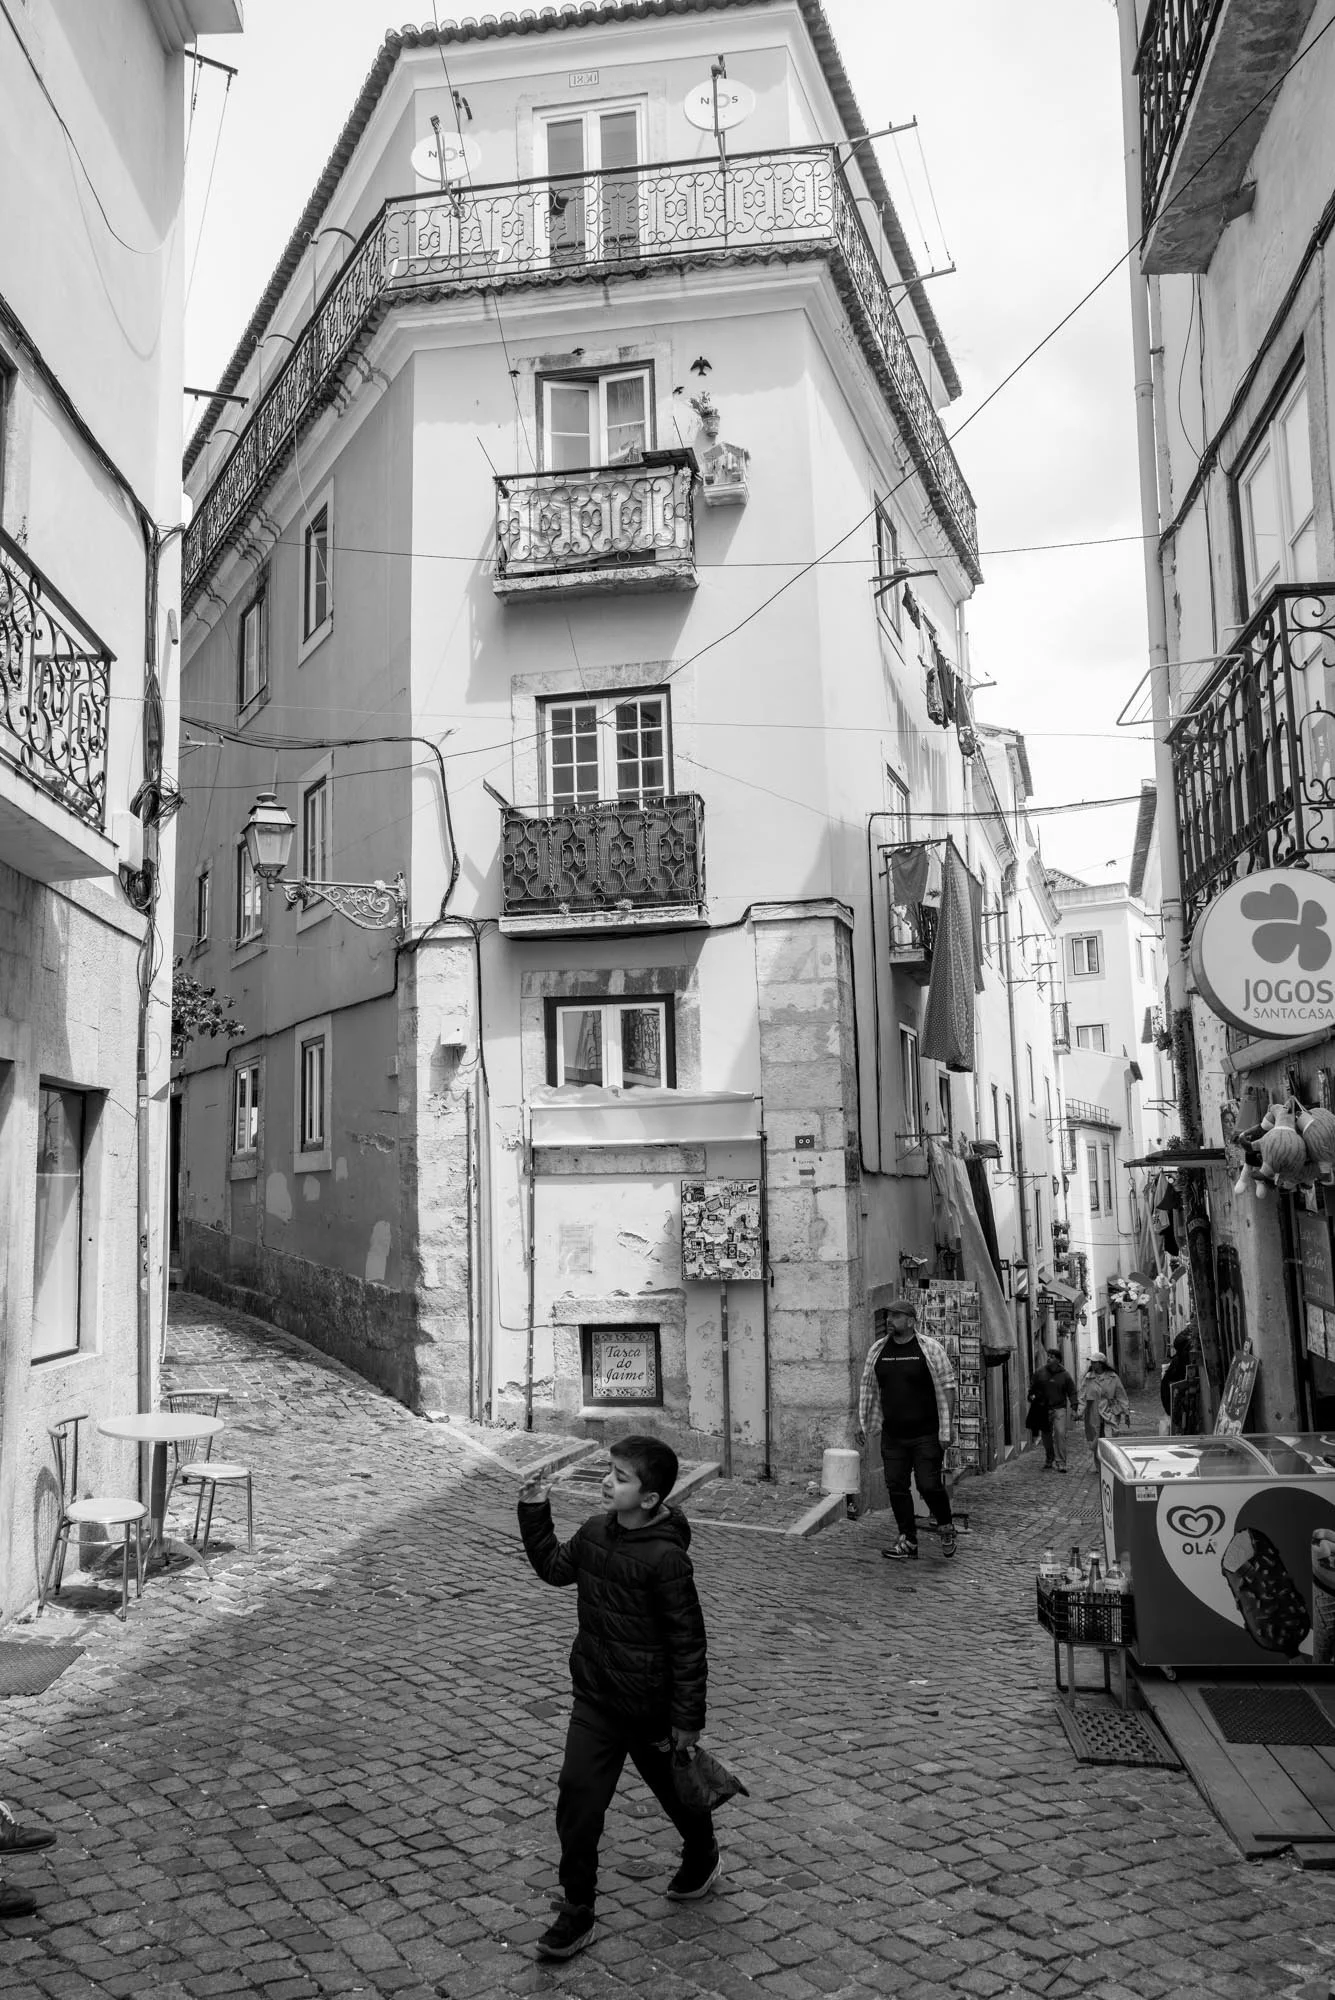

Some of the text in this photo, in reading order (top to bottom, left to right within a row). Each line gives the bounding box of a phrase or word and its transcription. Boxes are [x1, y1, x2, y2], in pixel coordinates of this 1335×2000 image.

[1242, 978, 1334, 1011] JOGOS
[605, 1345, 641, 1358] Tasca
[616, 1358, 632, 1369] do
[603, 1368, 645, 1384] Jaime
[1182, 1538, 1217, 1555] OLÁ
